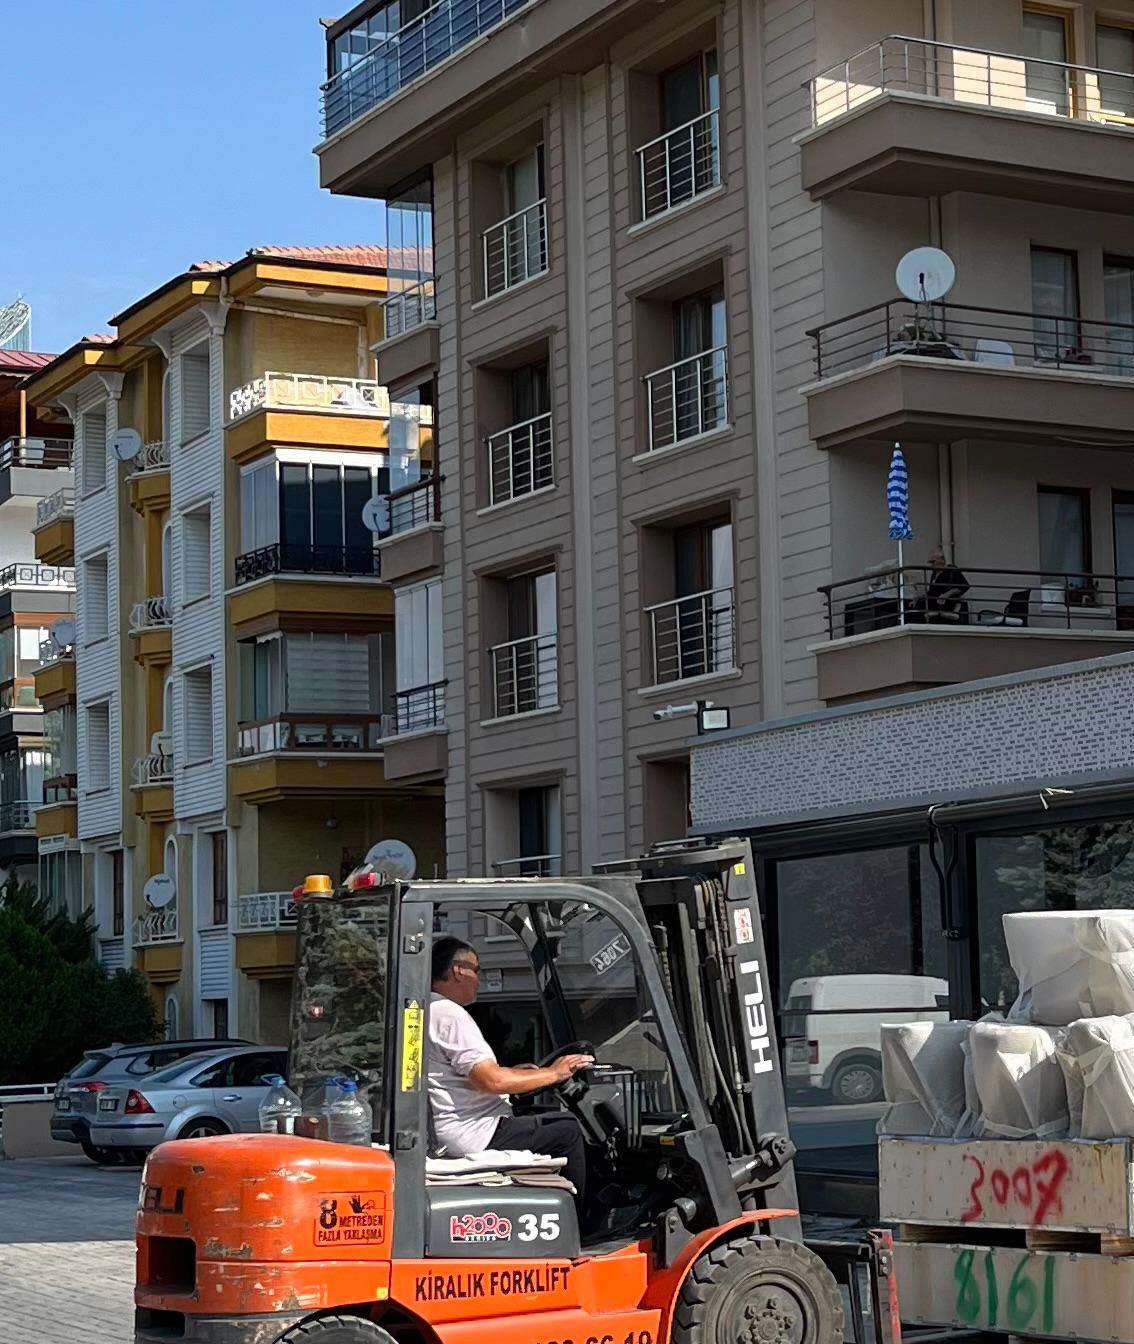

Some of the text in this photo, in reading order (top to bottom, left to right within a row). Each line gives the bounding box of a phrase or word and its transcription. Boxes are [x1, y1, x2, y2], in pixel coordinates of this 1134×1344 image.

[740, 960, 774, 1074] HELI
[320, 1199, 337, 1229] 8
[517, 1213, 560, 1242] 35
[415, 1262, 570, 1301] KİRALIK FORKLİFT
